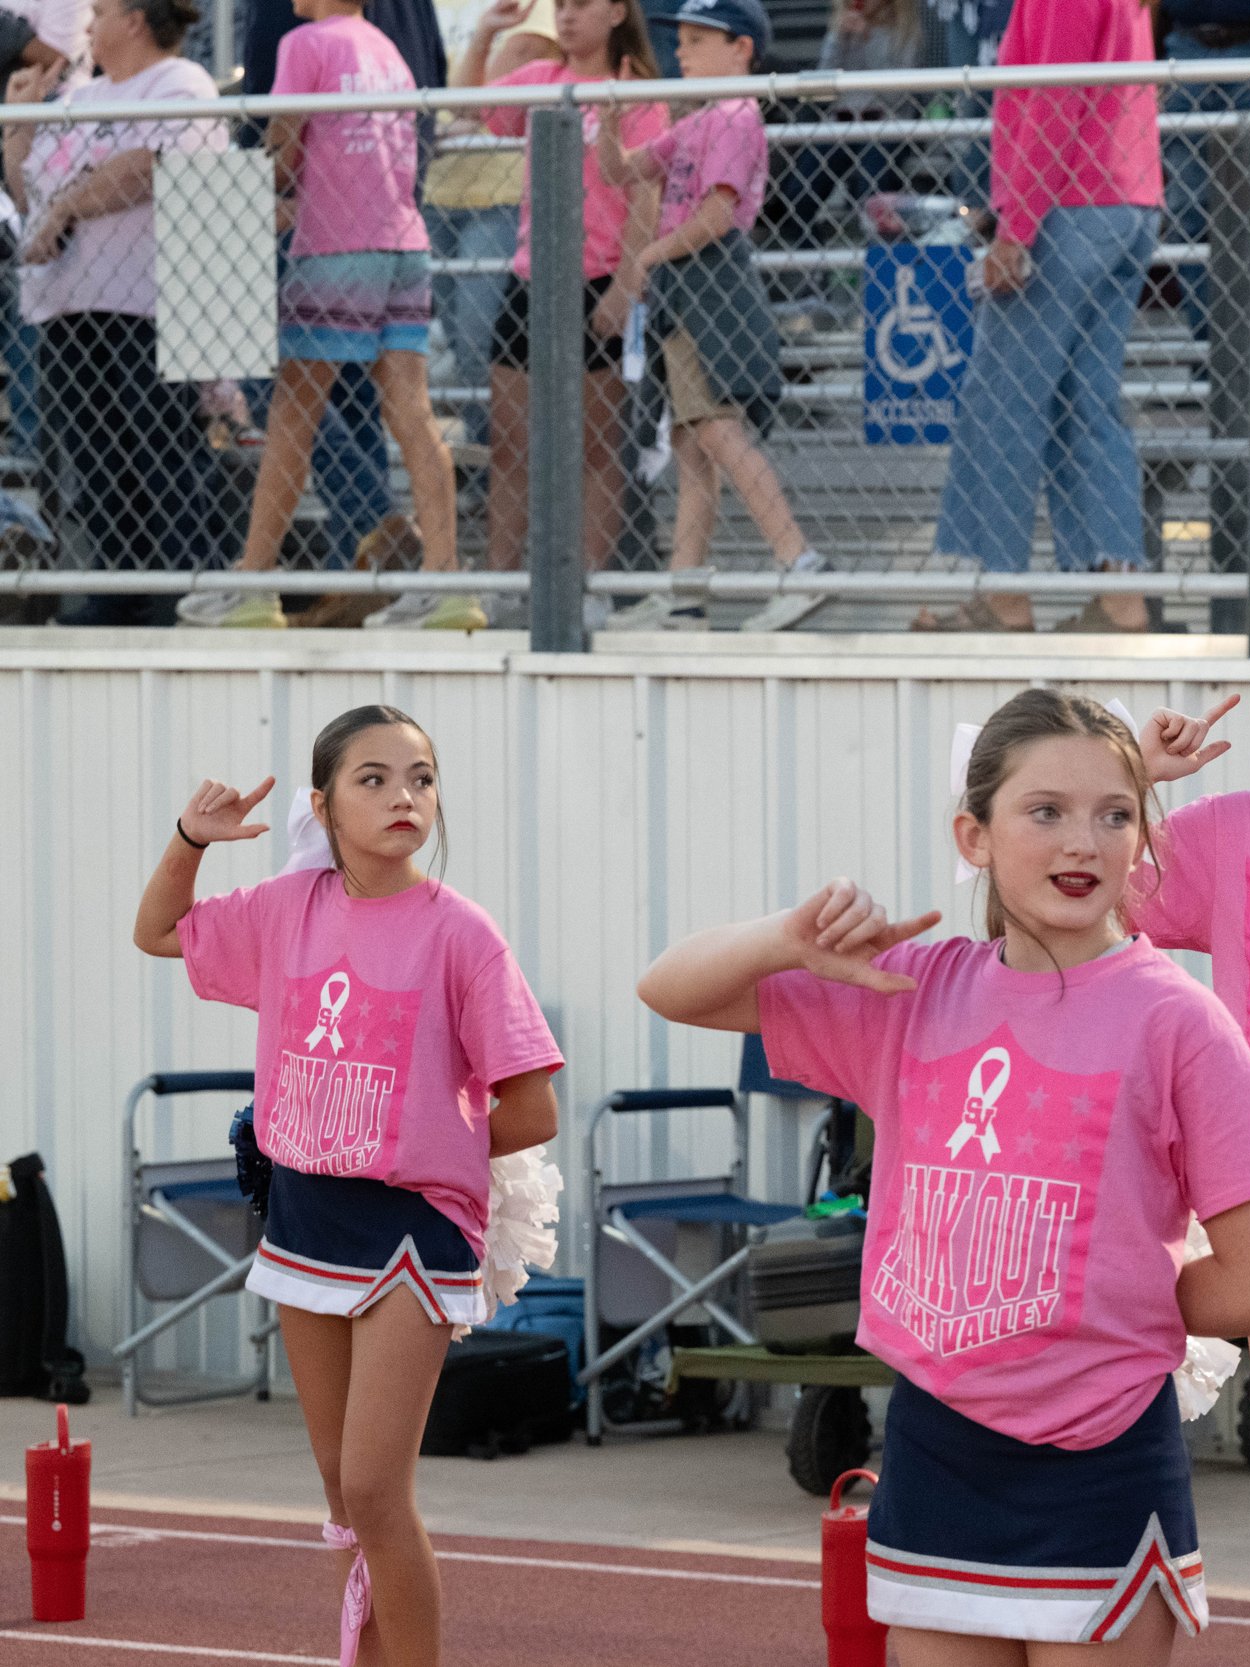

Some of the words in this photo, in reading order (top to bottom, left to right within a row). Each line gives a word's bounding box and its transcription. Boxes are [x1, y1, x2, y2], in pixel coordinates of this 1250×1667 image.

[317, 1007, 342, 1037] SV
[318, 1060, 397, 1155] OUT
[962, 1096, 997, 1137] SV
[964, 1172, 1081, 1311] OUT
[870, 1266, 904, 1314] IN
[900, 1288, 938, 1352] THE
[940, 1293, 1060, 1357] VALLEY
